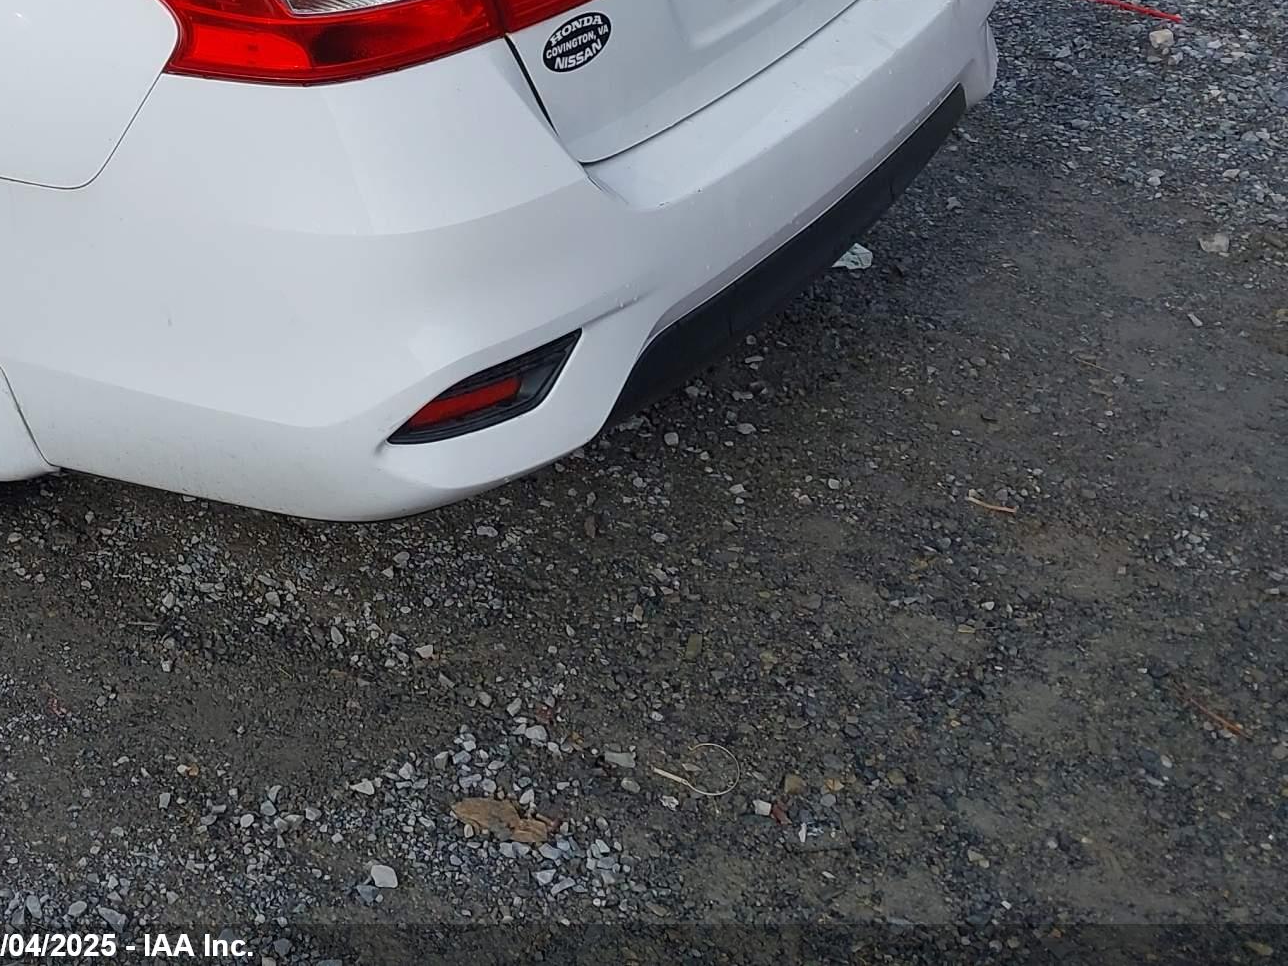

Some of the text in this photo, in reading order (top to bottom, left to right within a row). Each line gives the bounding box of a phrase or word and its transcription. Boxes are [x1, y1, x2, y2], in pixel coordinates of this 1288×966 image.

[546, 25, 608, 59] COVINGTON, VA
[550, 15, 603, 46] HONDA
[555, 39, 602, 69] NISSAN
